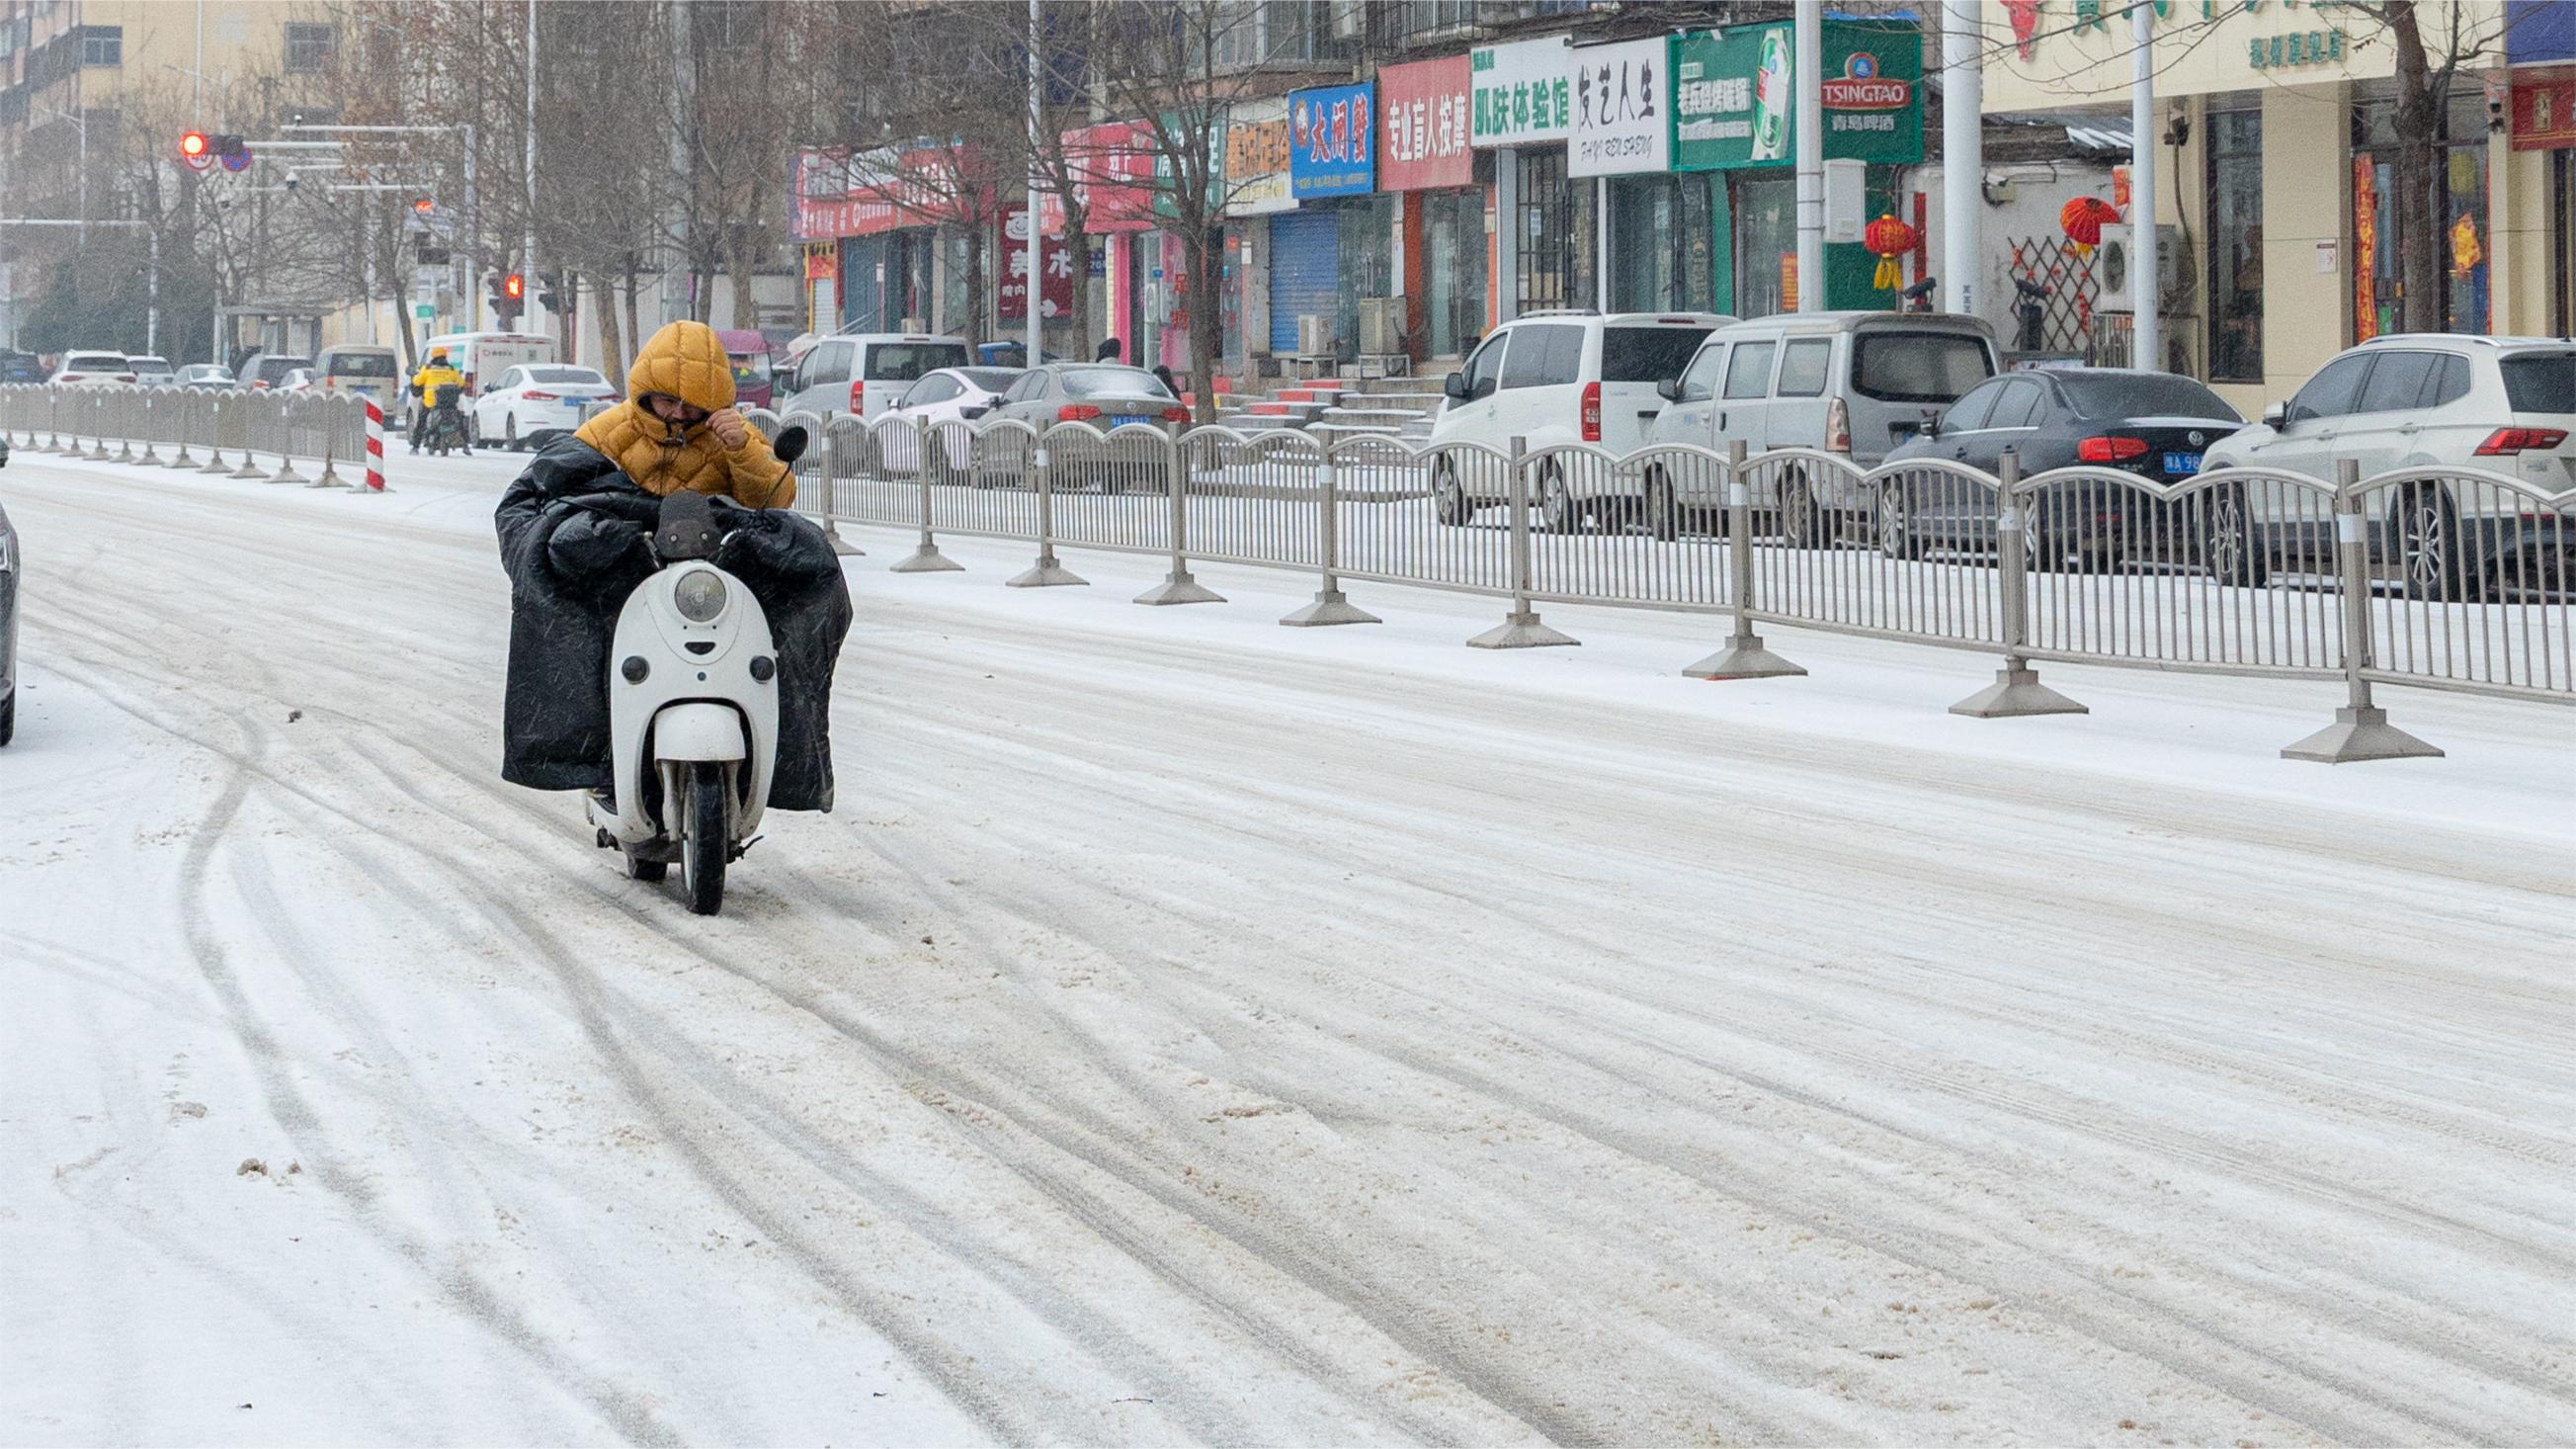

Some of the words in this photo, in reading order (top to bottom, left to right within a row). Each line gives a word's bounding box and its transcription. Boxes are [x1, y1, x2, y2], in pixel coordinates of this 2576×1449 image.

[1474, 75, 1568, 136] 肌肤体验馆
[1822, 84, 1905, 103] TSINGTAO
[1387, 91, 1465, 162] 专业盲人按摩
